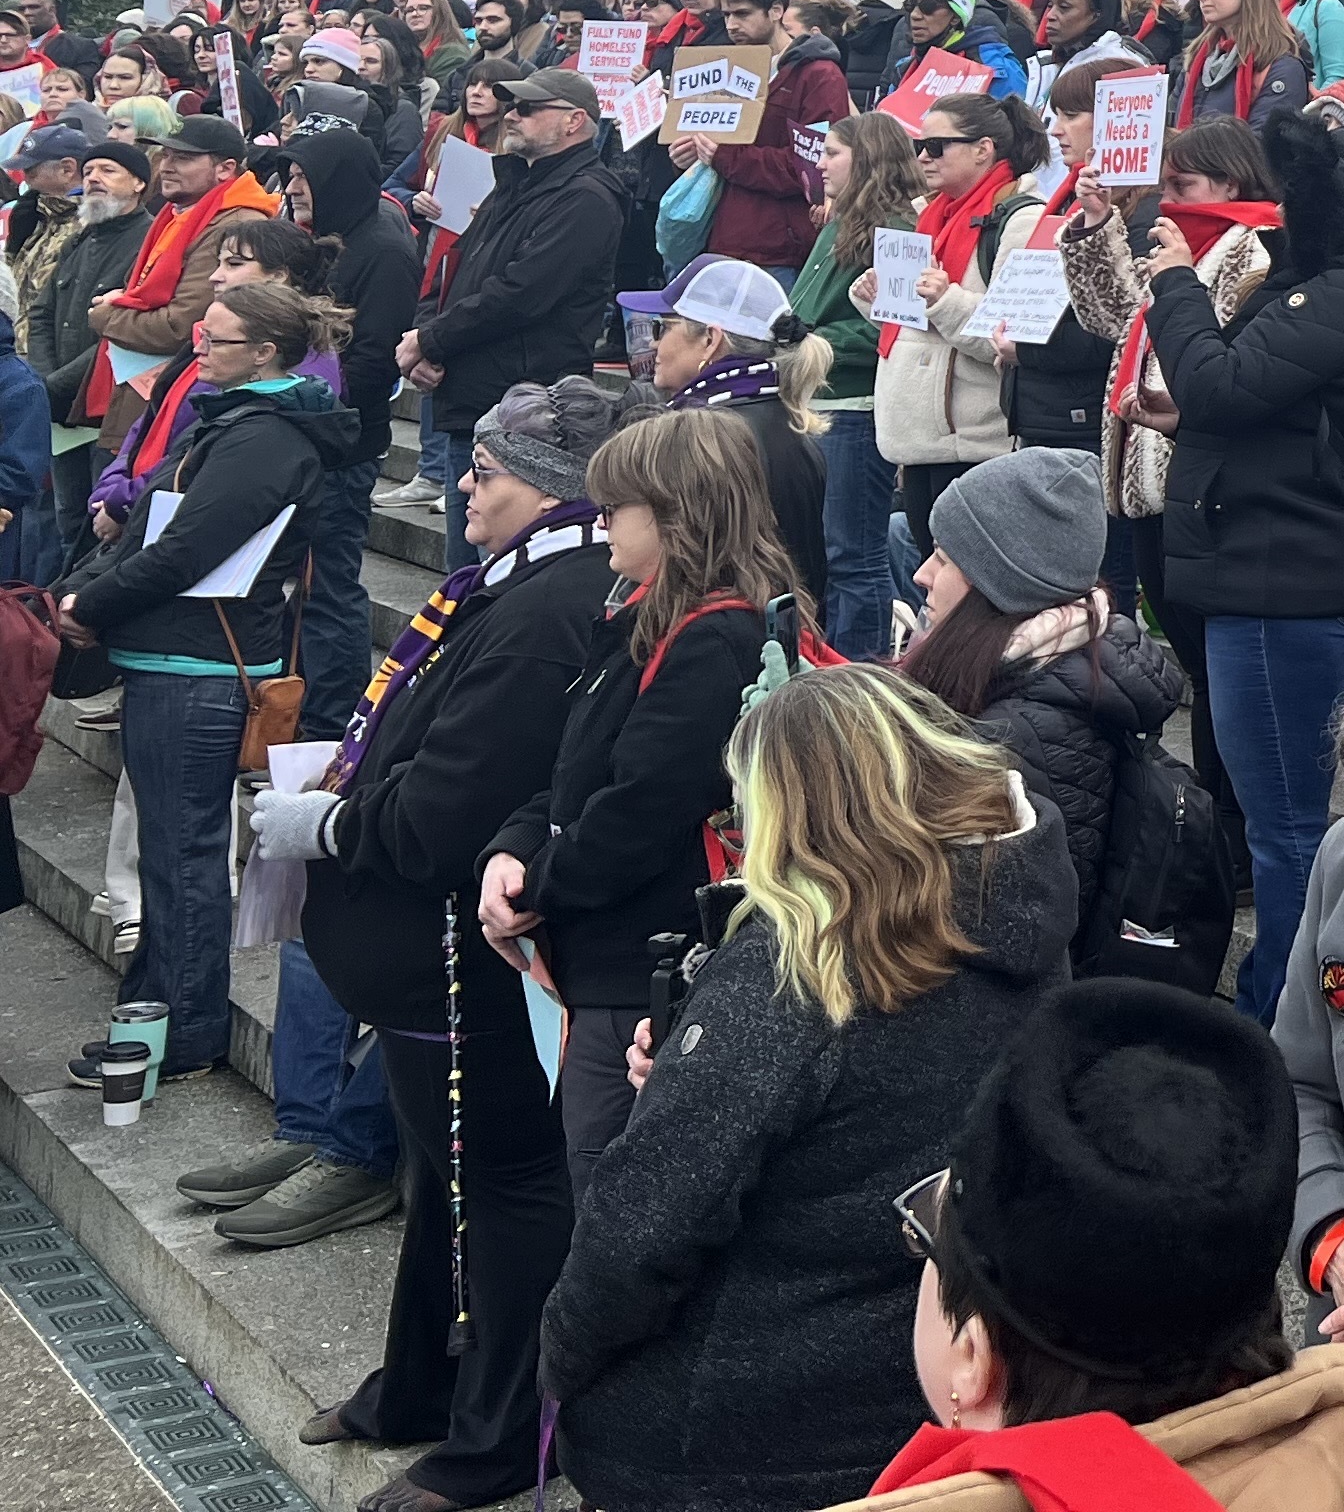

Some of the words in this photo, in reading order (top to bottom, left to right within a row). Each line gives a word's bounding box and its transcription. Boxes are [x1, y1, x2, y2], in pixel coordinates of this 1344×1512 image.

[587, 27, 613, 38] FULLY
[617, 27, 642, 38] FUND
[589, 42, 636, 54] HOMELESS
[589, 56, 631, 67] SERVICES
[678, 68, 722, 92] FUND
[735, 75, 755, 93] THE
[914, 68, 964, 97] People
[1107, 91, 1153, 118] Everyone
[682, 110, 738, 125] PEOPLE
[792, 128, 812, 148] Tax
[1105, 118, 1138, 142] Needs
[1142, 123, 1149, 139] a
[1101, 146, 1149, 174] HOME
